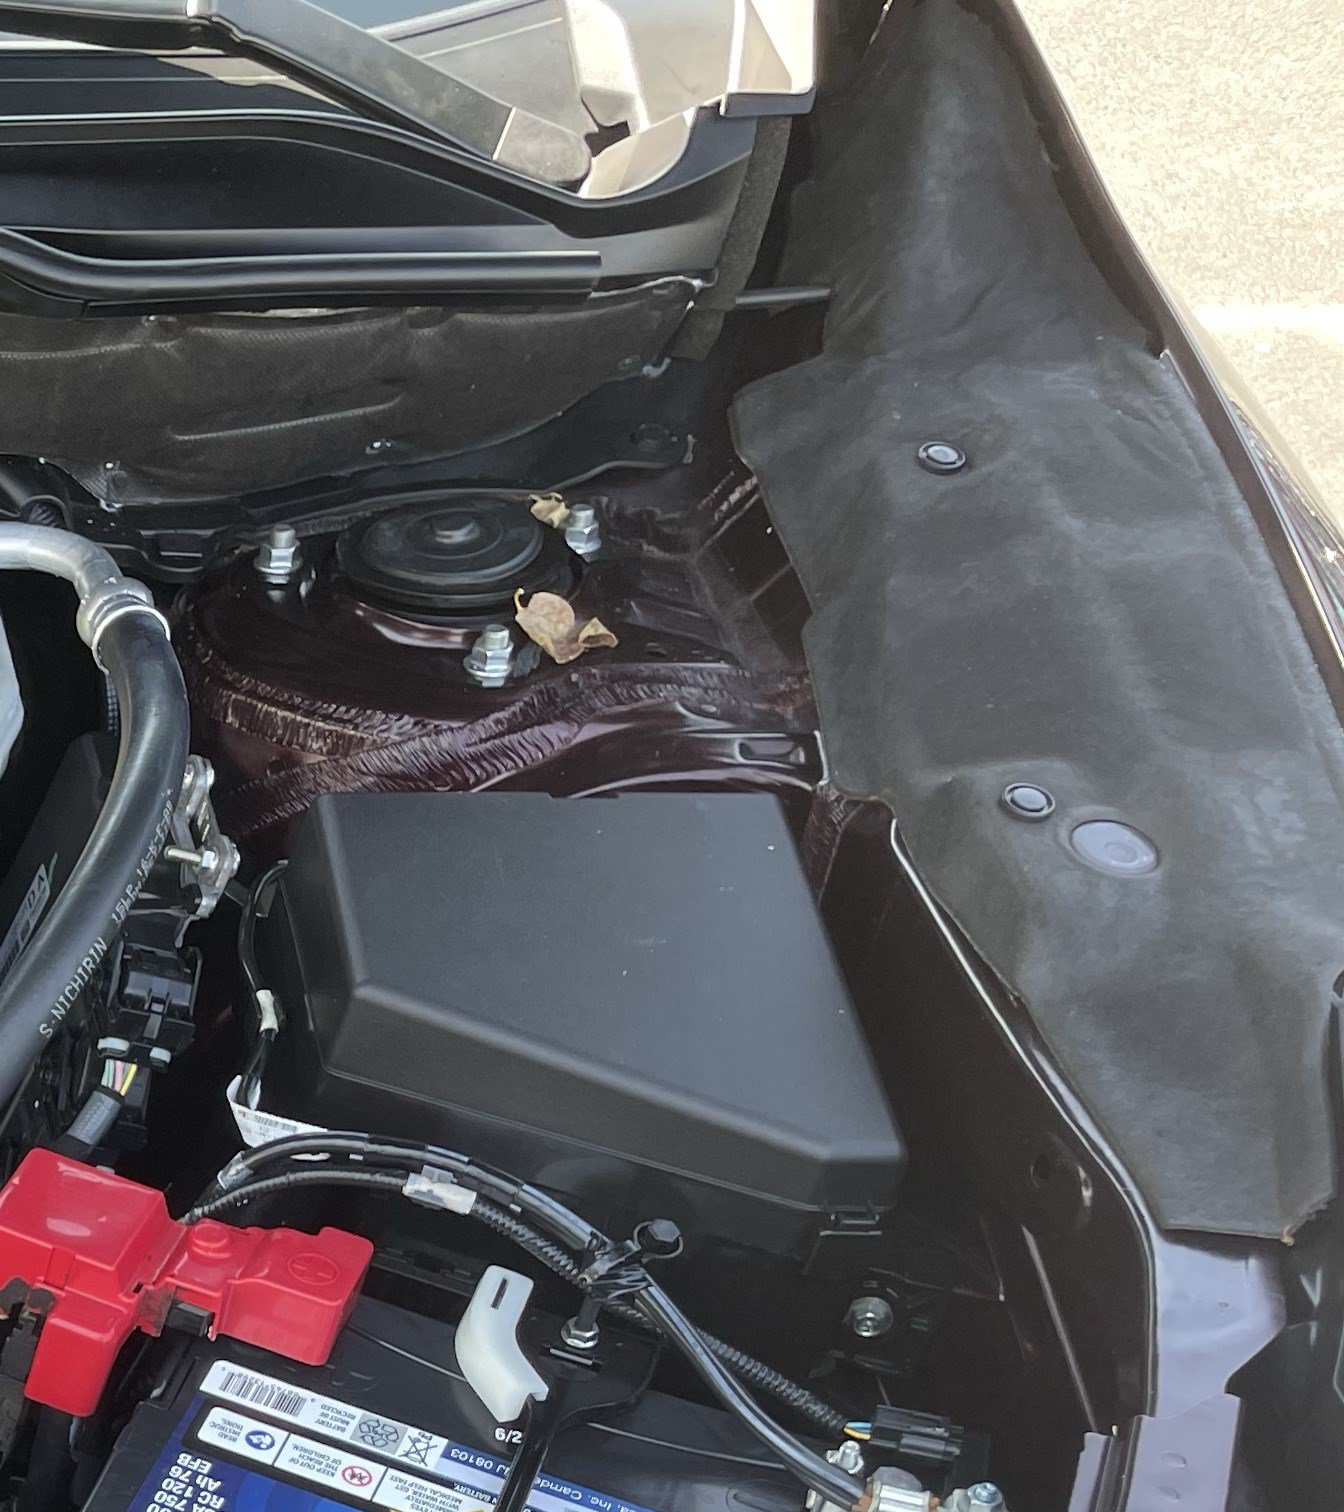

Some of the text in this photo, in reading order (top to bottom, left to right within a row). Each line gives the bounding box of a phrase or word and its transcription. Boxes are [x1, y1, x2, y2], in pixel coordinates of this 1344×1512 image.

[174, 1450, 212, 1474] EFB
[449, 1446, 494, 1470] 08103
[167, 1463, 222, 1493] Ah 76
[152, 1488, 188, 1512] 750
[159, 1476, 225, 1510] RC 120
